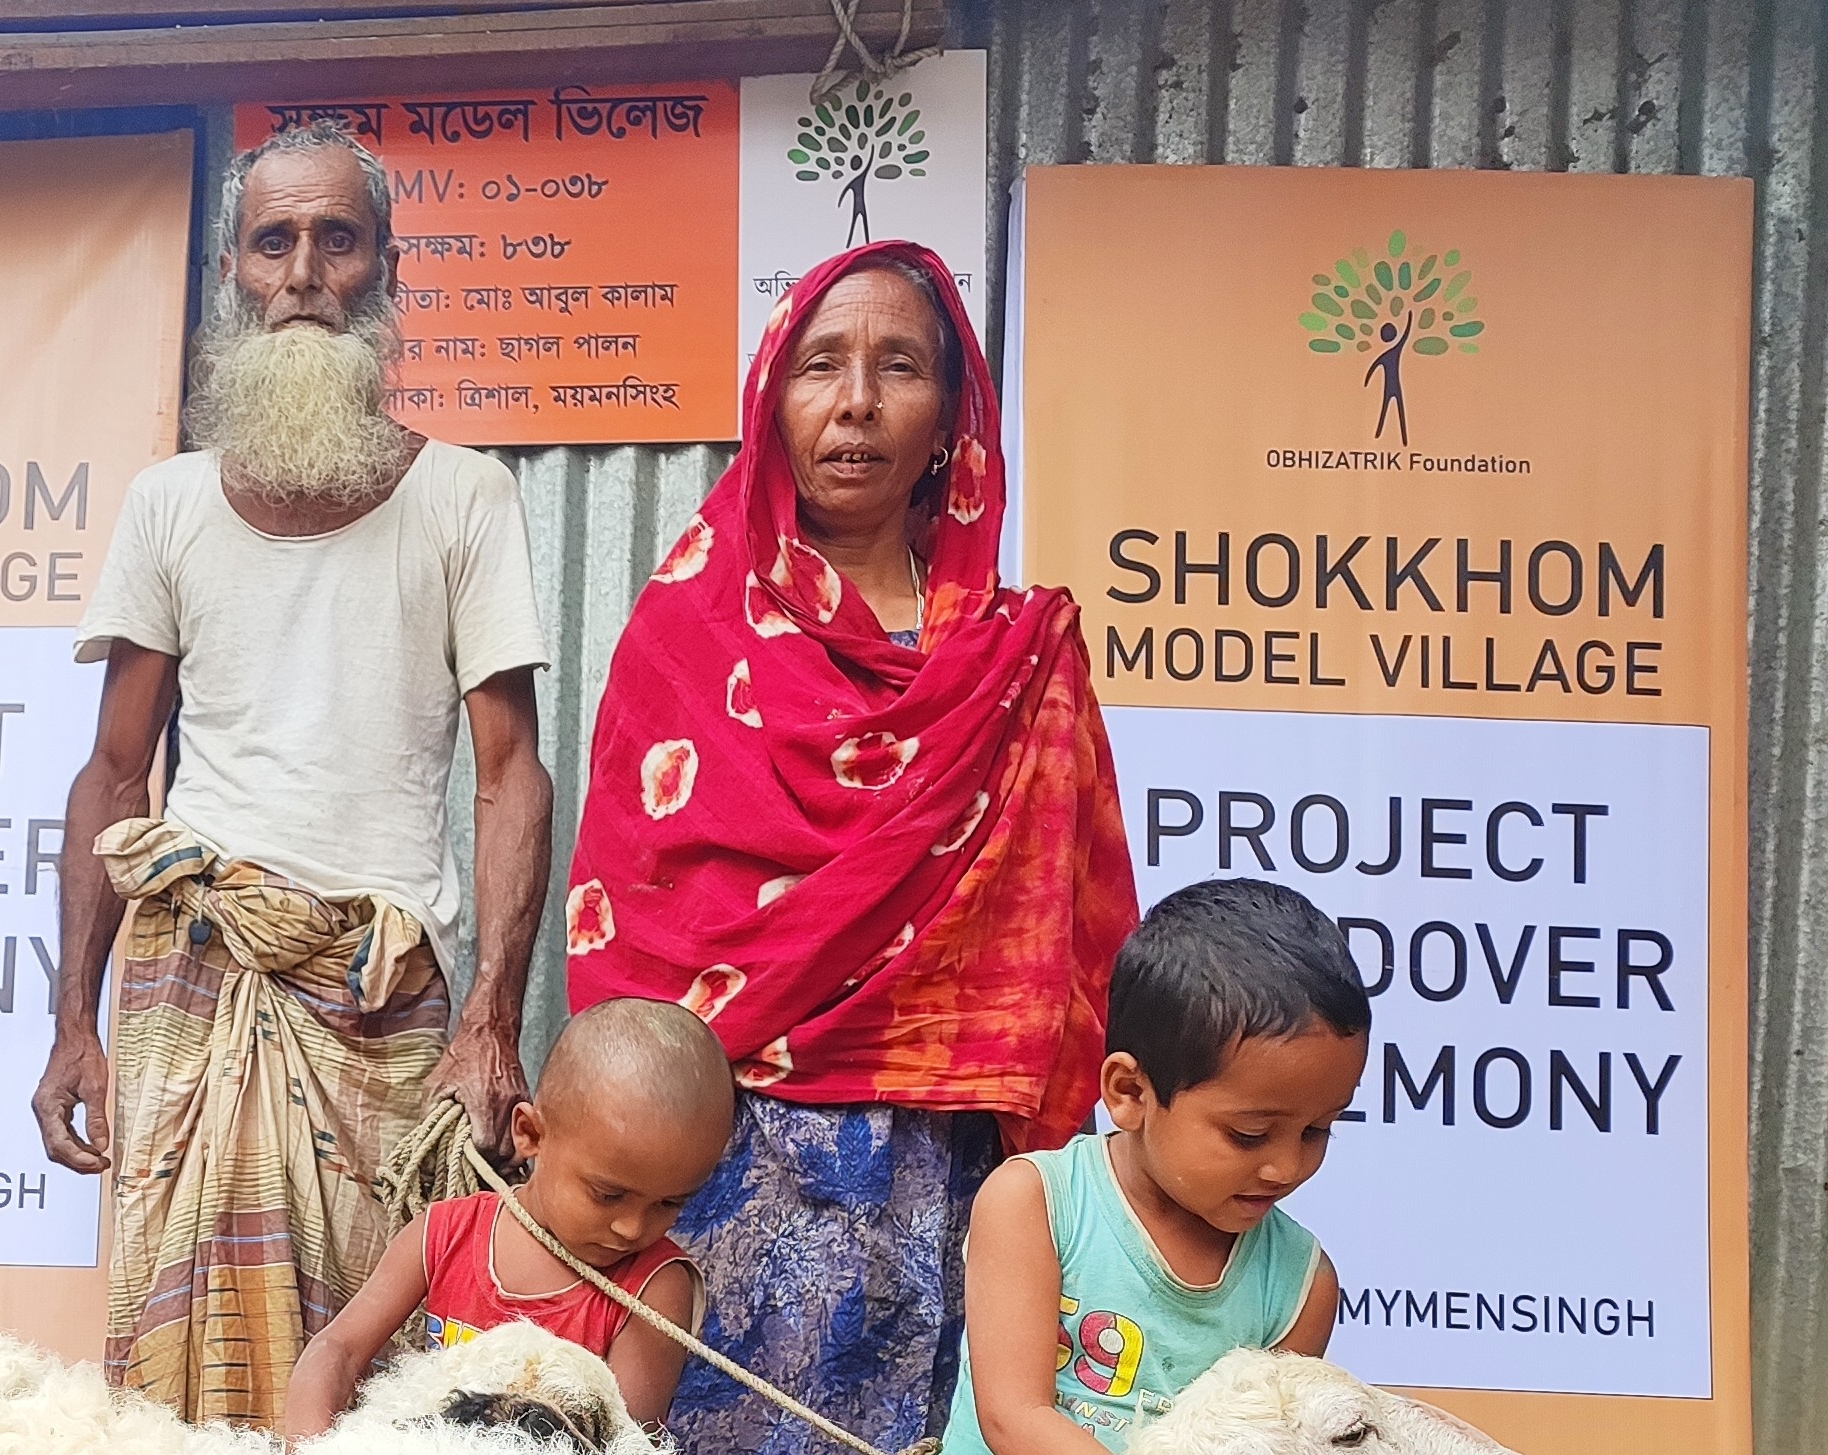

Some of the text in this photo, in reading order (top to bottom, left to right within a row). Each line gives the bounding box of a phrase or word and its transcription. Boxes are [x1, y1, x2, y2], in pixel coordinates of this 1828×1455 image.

[400, 99, 537, 145] মডেল
[549, 84, 710, 143] ভিলেজ
[393, 168, 609, 204] MV: ০১-০৩৮
[501, 232, 571, 261] ৮৩৮
[392, 279, 451, 317] হীতা:
[520, 283, 593, 317] আবুল
[598, 280, 679, 310] কালাম
[433, 336, 487, 362] নাম:
[496, 333, 564, 363] ছাগল
[573, 331, 641, 358] পালন
[456, 379, 540, 415] ত্রিশাল,
[548, 375, 681, 411] ময়মনসিংহ
[1266, 449, 1532, 476] OBHIZATRIK Foundation
[1105, 528, 1666, 621] SHOKKHOM
[1104, 625, 1665, 698] MODEL VILLAGE
[1145, 787, 1610, 884] PROJECT
[1336, 916, 1677, 1013] DOVER
[1334, 1041, 1684, 1135] MONY
[1338, 1287, 1656, 1338] MYMENSINGH
